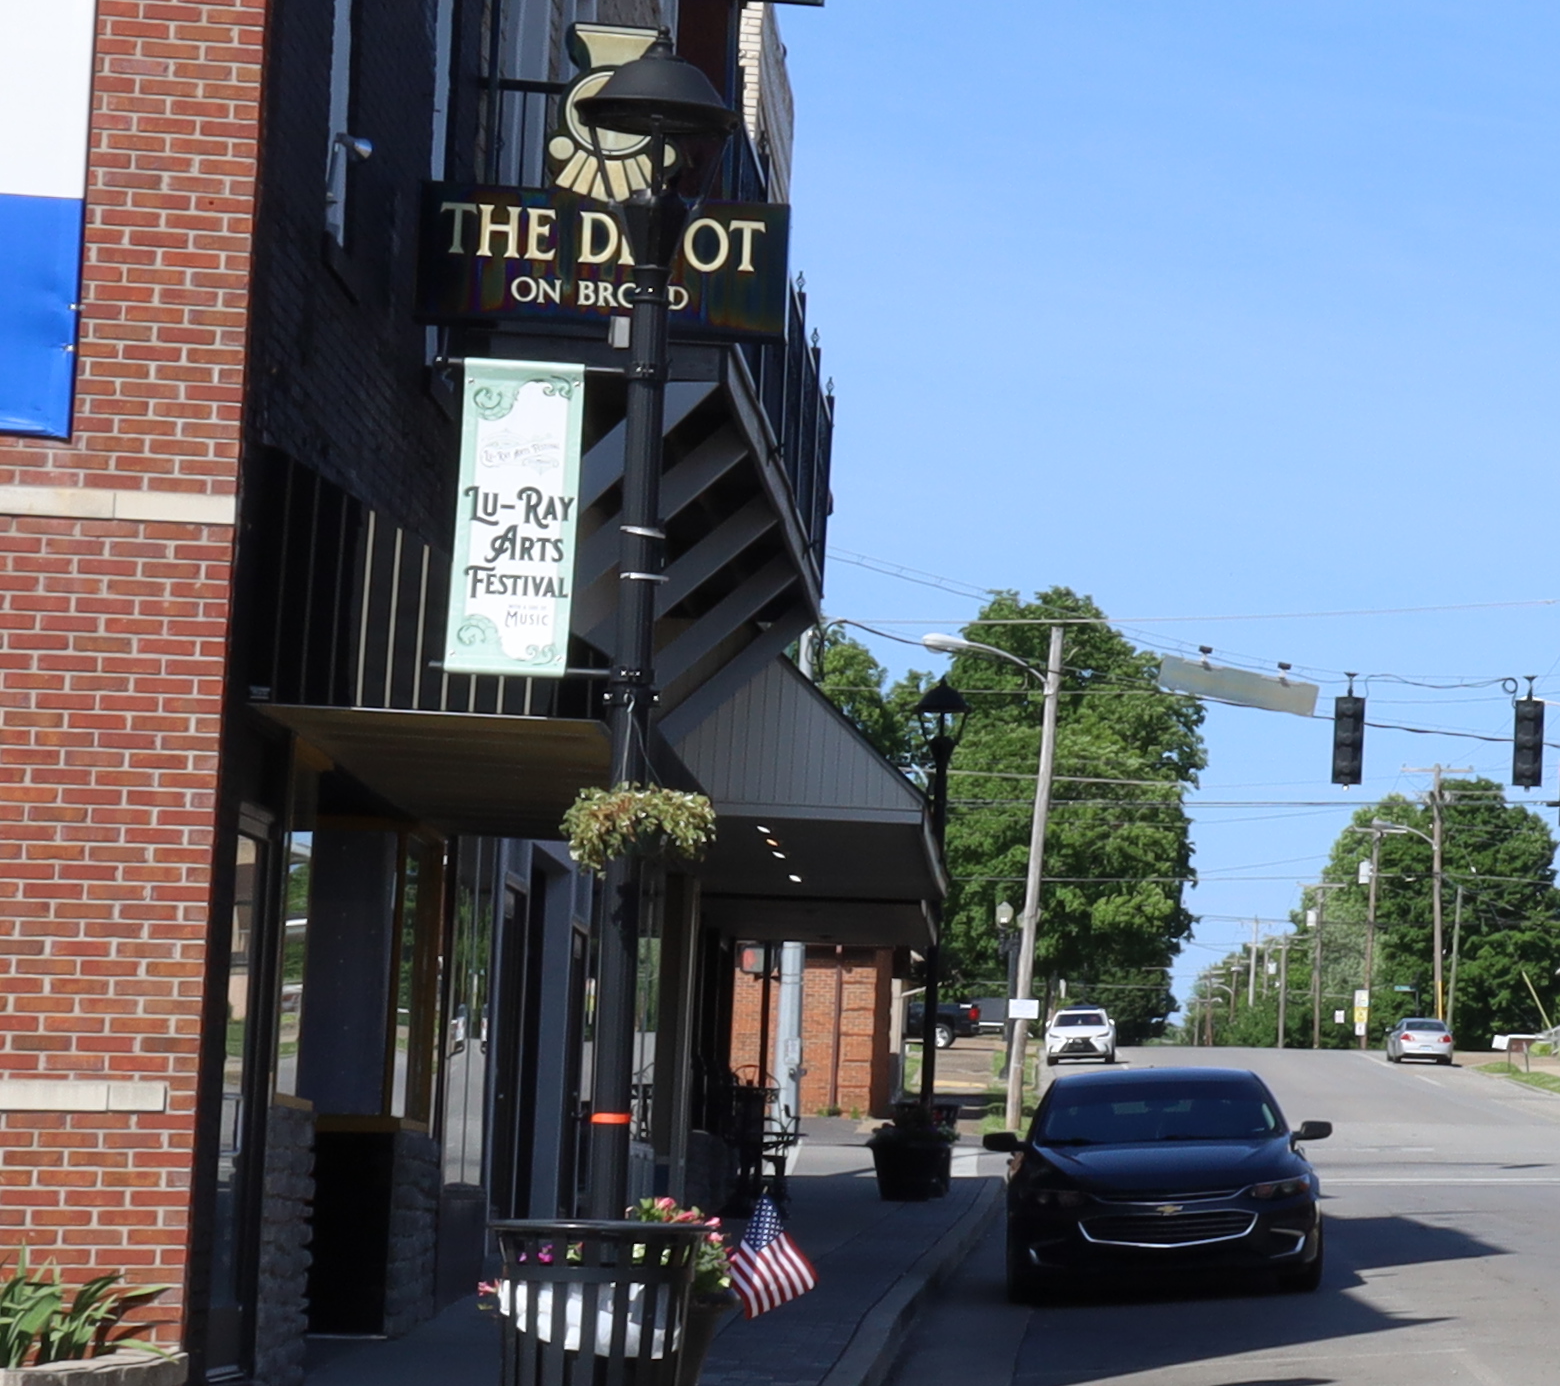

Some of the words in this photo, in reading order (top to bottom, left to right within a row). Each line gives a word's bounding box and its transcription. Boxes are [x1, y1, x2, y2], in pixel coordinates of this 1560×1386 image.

[441, 202, 557, 262] THE
[577, 210, 767, 273] DOT
[510, 276, 563, 305] ON
[577, 280, 690, 311] BROD
